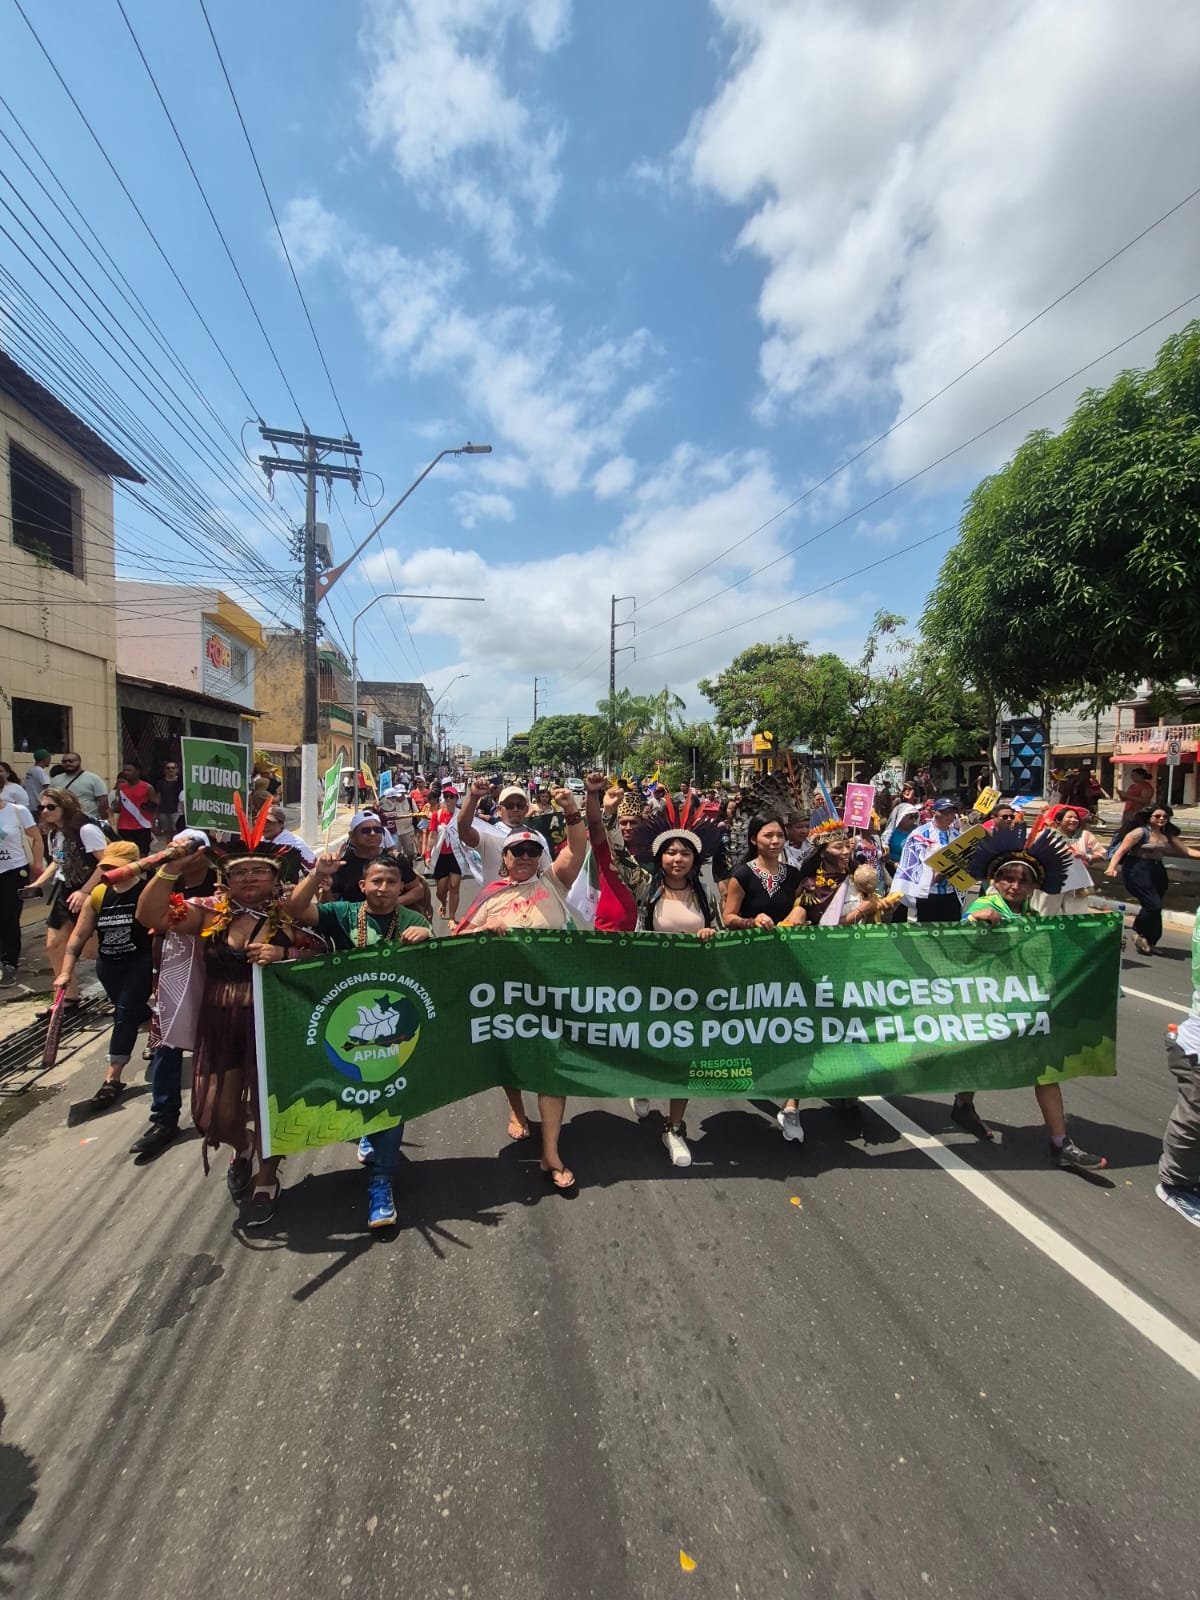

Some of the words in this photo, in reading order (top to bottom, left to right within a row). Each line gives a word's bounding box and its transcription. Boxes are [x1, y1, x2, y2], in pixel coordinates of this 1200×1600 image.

[191, 764, 241, 789] FUTURO
[192, 799, 238, 816] ANCESTRA
[469, 983, 496, 1008] O
[503, 981, 642, 1013] FUTURO
[649, 986, 699, 1012] DO
[706, 982, 808, 1012] CLIMA
[815, 975, 835, 1008] É
[842, 975, 1050, 1008] ANCESTRAL
[306, 1004, 325, 1046] POVOS
[320, 972, 378, 1006] INDÍGENAS
[379, 972, 396, 981] DO
[397, 975, 436, 1020] AMAZONAS
[470, 1013, 640, 1049] ESCUTEM
[647, 1020, 695, 1049] OS
[701, 1016, 815, 1047] POVOS
[821, 1016, 870, 1044] DA
[875, 1011, 1050, 1043] FLORESTA
[354, 1043, 400, 1062] APIAM
[700, 1057, 752, 1069] RESPOSTA
[689, 1069, 729, 1078] SOMOS
[341, 1086, 381, 1104] COP
[384, 1076, 407, 1098] 30
